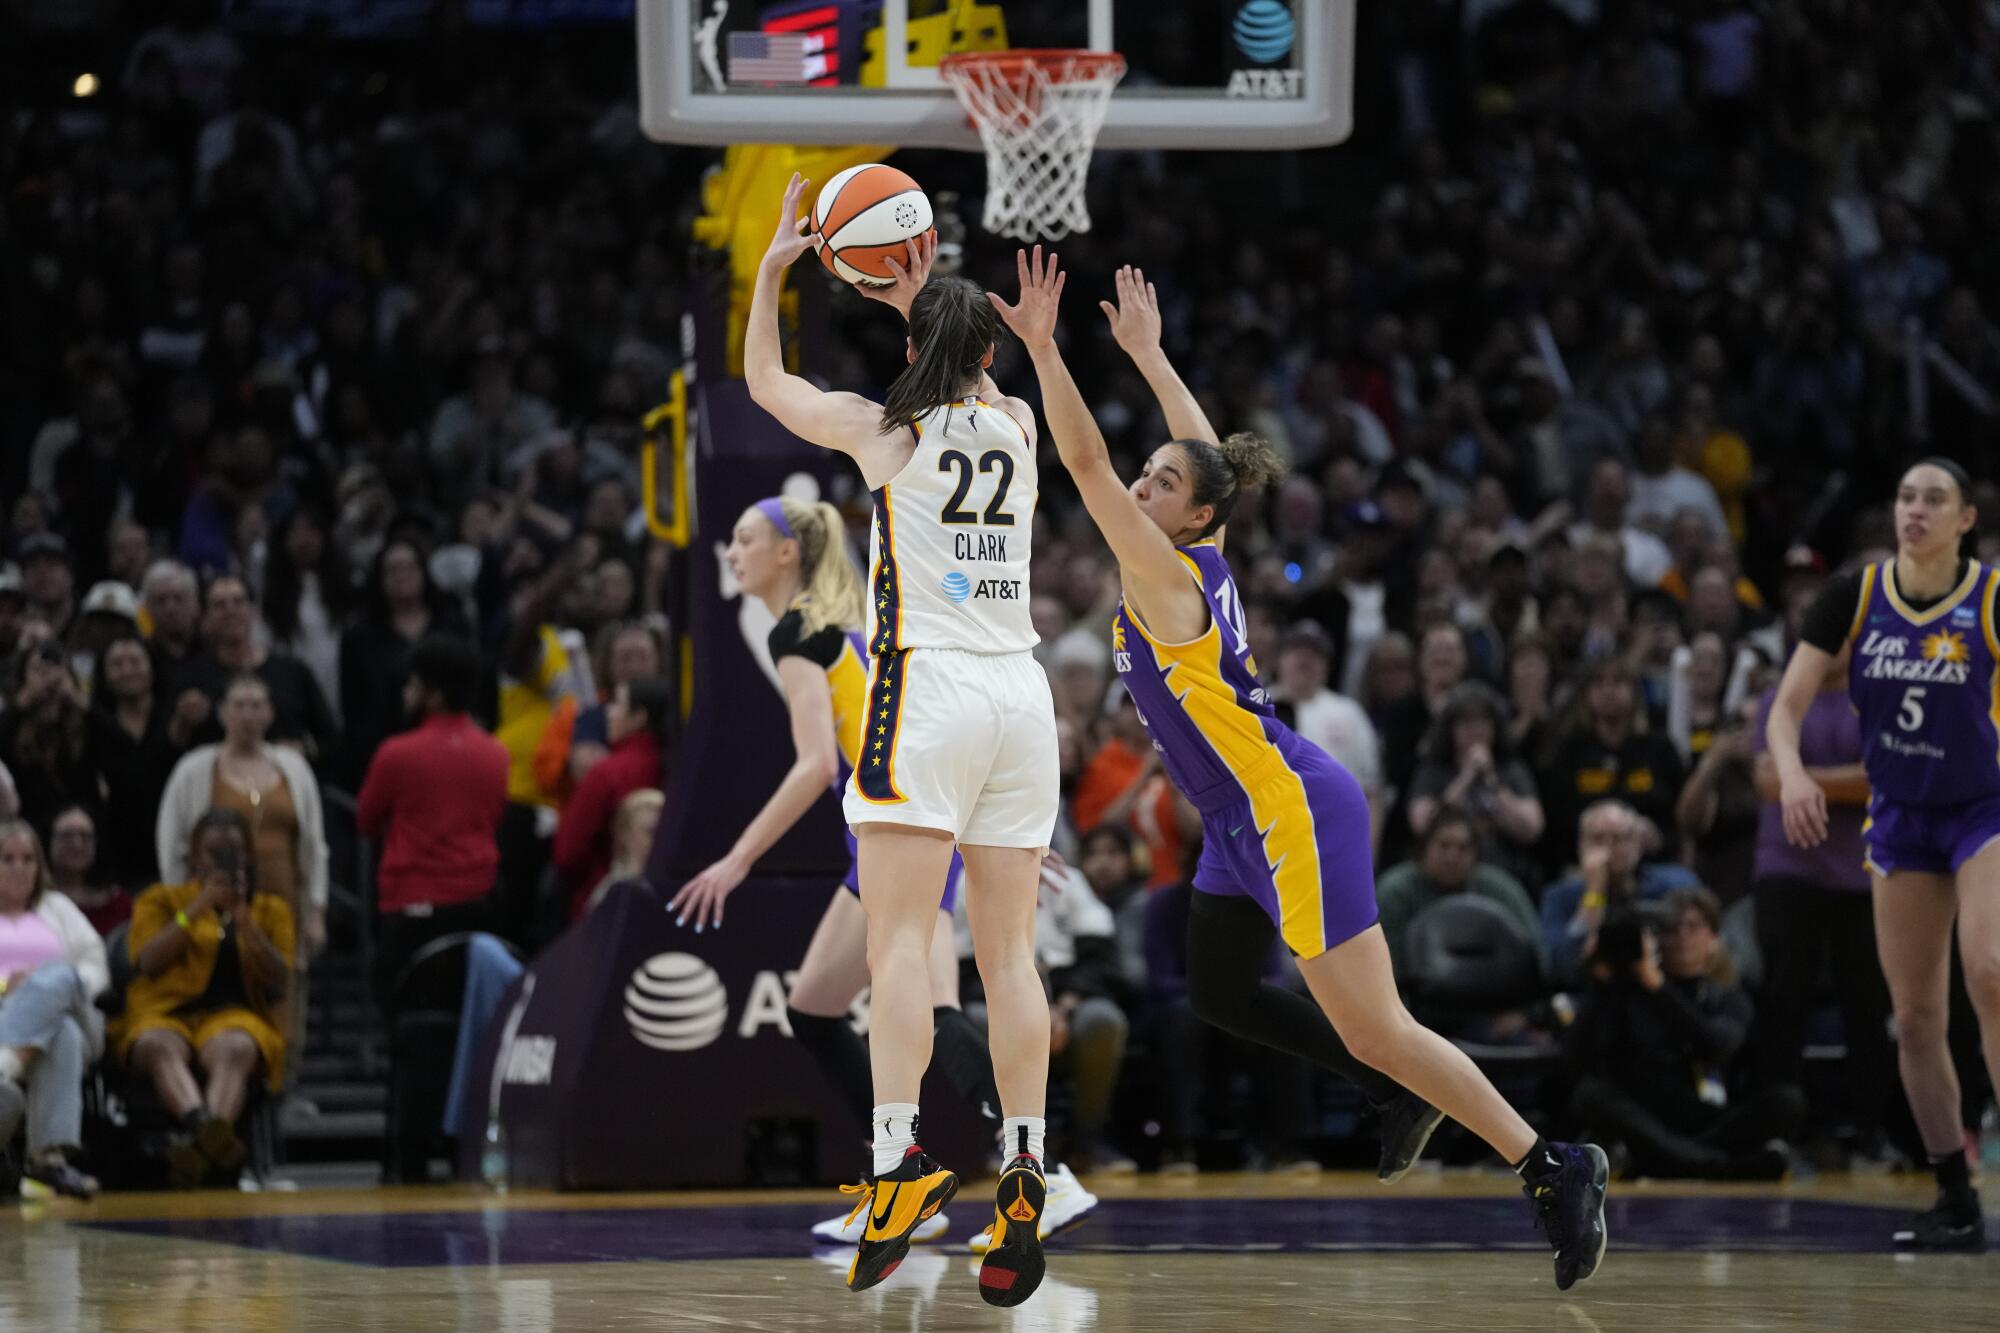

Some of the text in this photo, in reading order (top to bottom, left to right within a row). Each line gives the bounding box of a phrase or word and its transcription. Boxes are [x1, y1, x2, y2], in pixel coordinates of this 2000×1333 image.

[1226, 69, 1302, 98] AT&T
[938, 449, 1015, 526] 22
[955, 532, 1007, 563] CLARK
[973, 579, 1021, 600] AT&T
[1896, 686, 1927, 732] 5
